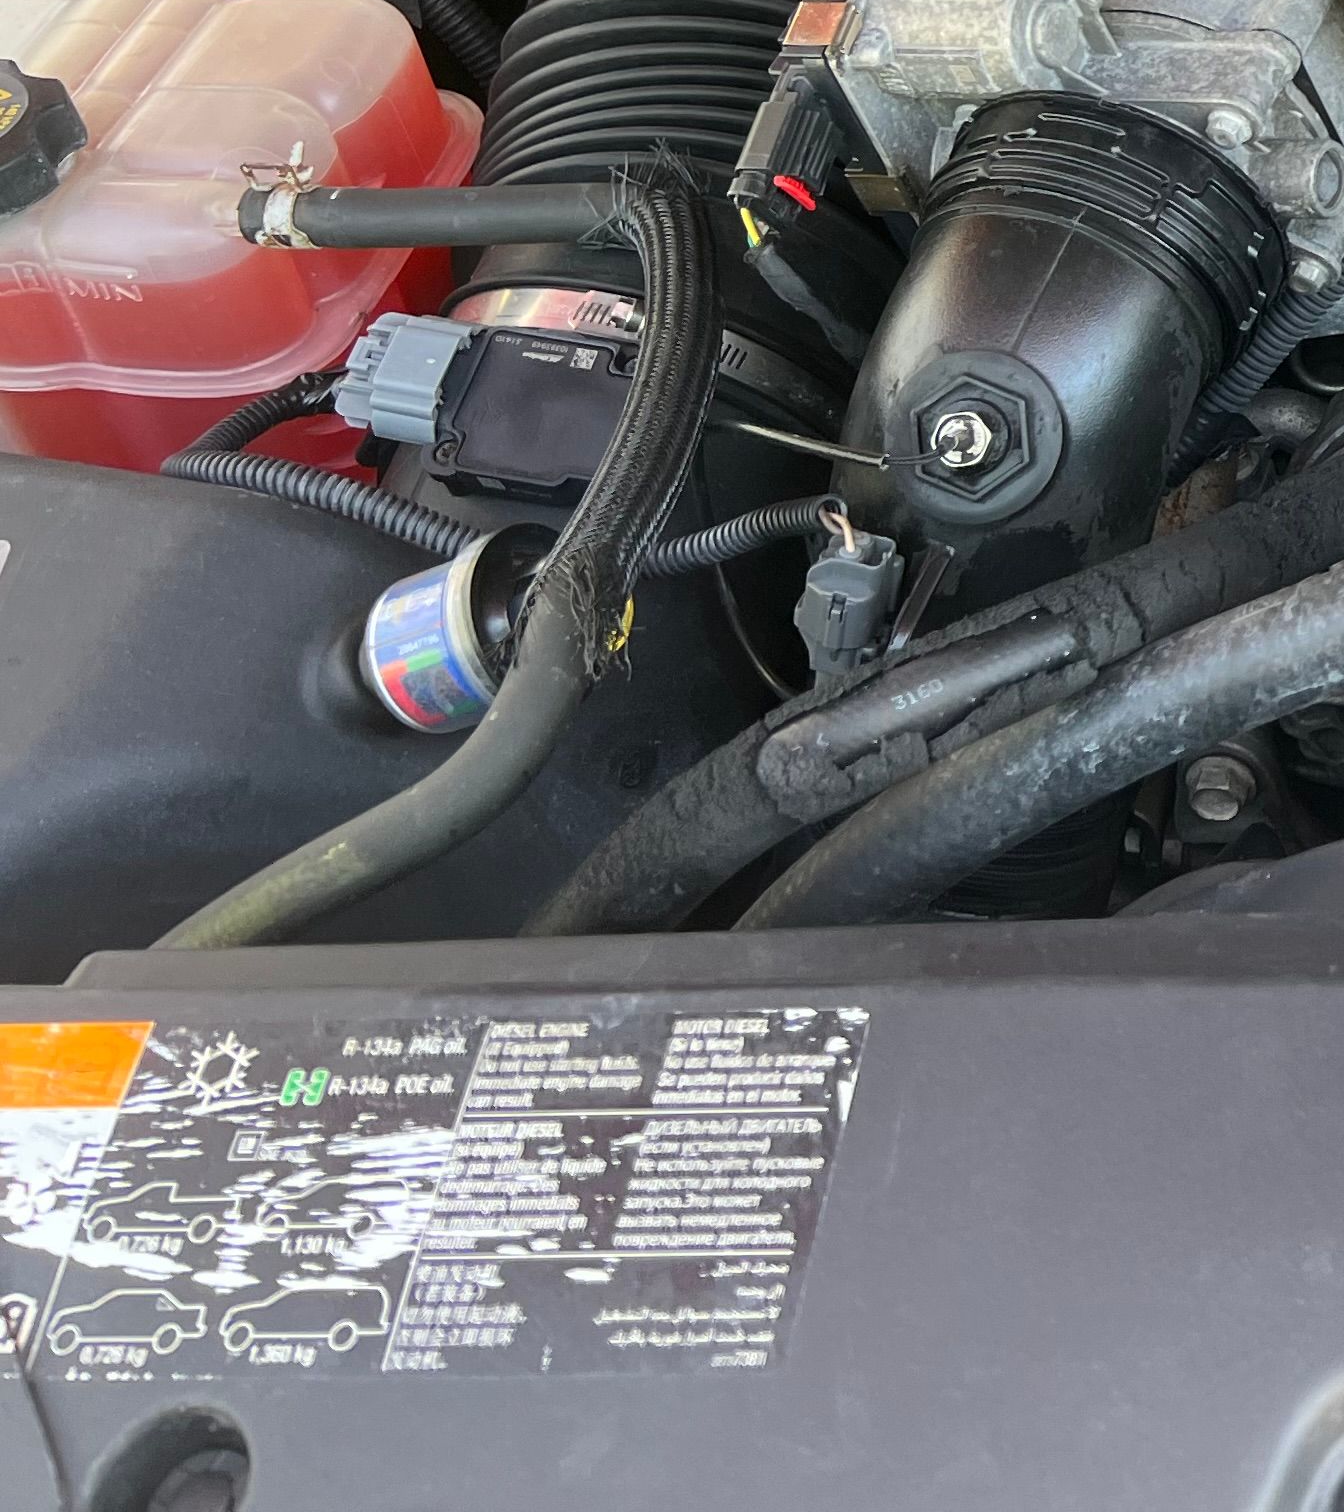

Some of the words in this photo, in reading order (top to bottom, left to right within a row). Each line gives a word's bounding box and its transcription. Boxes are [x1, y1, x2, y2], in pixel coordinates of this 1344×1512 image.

[64, 278, 143, 302] MIN
[891, 678, 944, 710] 3160
[491, 1023, 536, 1038] DIESEL
[540, 1022, 590, 1037] ENGINE
[674, 1019, 722, 1035] MOTOR
[724, 1019, 769, 1034] DIESEL
[342, 1036, 403, 1056] R-134a
[408, 1035, 442, 1055] PAG
[443, 1036, 467, 1055] oil.
[502, 1039, 570, 1058] Equipped)
[478, 1060, 497, 1073] Do
[499, 1060, 521, 1072] not
[523, 1060, 547, 1072] use
[549, 1058, 598, 1073] starting
[756, 1054, 774, 1068] de
[328, 1075, 390, 1095] R-134a
[394, 1074, 430, 1094] POE
[430, 1075, 455, 1093] oil.
[543, 1076, 588, 1092] engine
[589, 1075, 643, 1091] damage
[467, 1095, 492, 1108] can
[726, 1091, 744, 1103] en
[745, 1089, 759, 1102] el
[458, 1122, 516, 1138] MOTEUR
[515, 1121, 564, 1138] DIESEL
[466, 1162, 492, 1175] pas
[541, 1159, 559, 1173] de
[560, 1158, 607, 1175] liquide
[448, 1216, 498, 1230] moteur
[567, 1215, 588, 1229] en
[161, 1235, 185, 1257] kg
[124, 1345, 149, 1368] kg
[293, 1343, 318, 1368] kg
